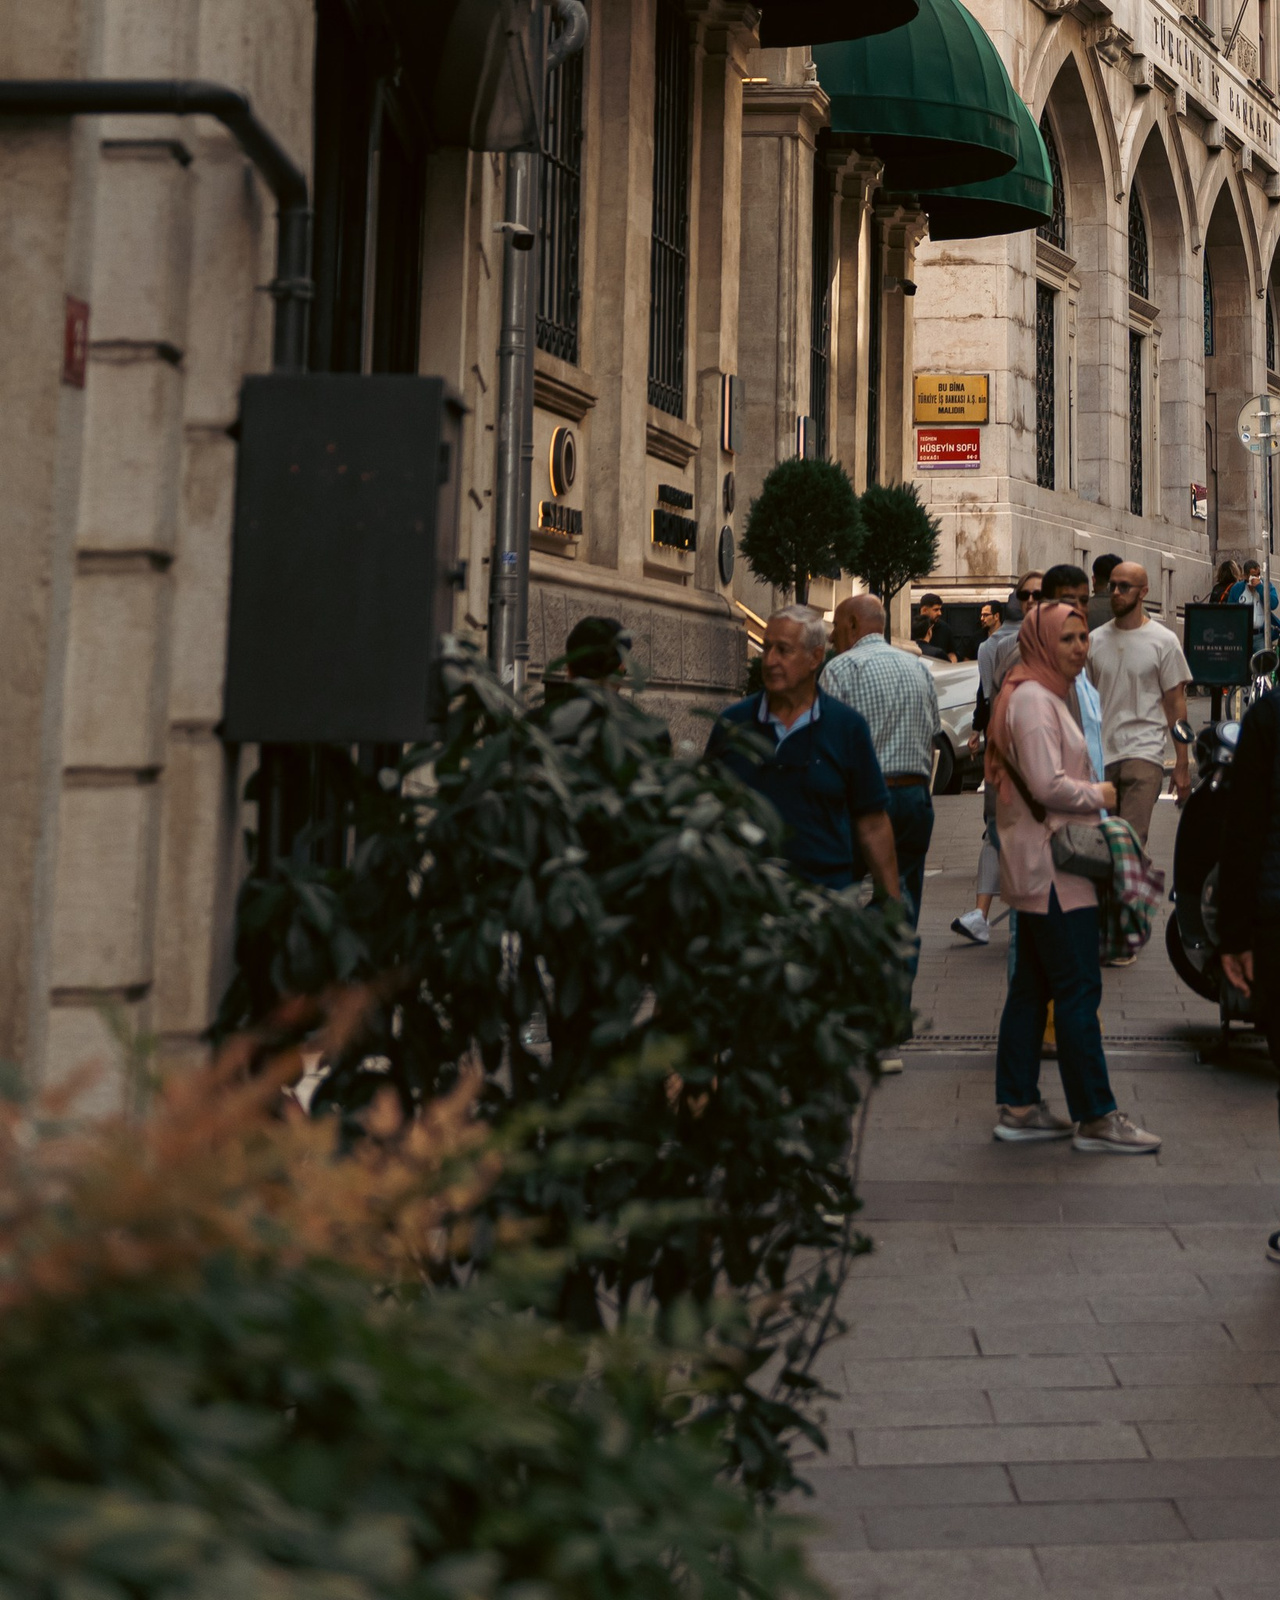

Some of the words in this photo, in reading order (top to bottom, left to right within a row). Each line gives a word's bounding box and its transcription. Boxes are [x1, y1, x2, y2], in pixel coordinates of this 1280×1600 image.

[1153, 16, 1202, 84] TÜRKİYE
[1211, 65, 1220, 103] İŞ
[1229, 86, 1272, 147] BANKASI
[938, 383, 948, 392] BU
[949, 381, 965, 392] BİNA
[918, 392, 937, 404] TÜRKİYE
[920, 443, 955, 453] HÜSEYİN
[956, 443, 977, 452] SOFU
